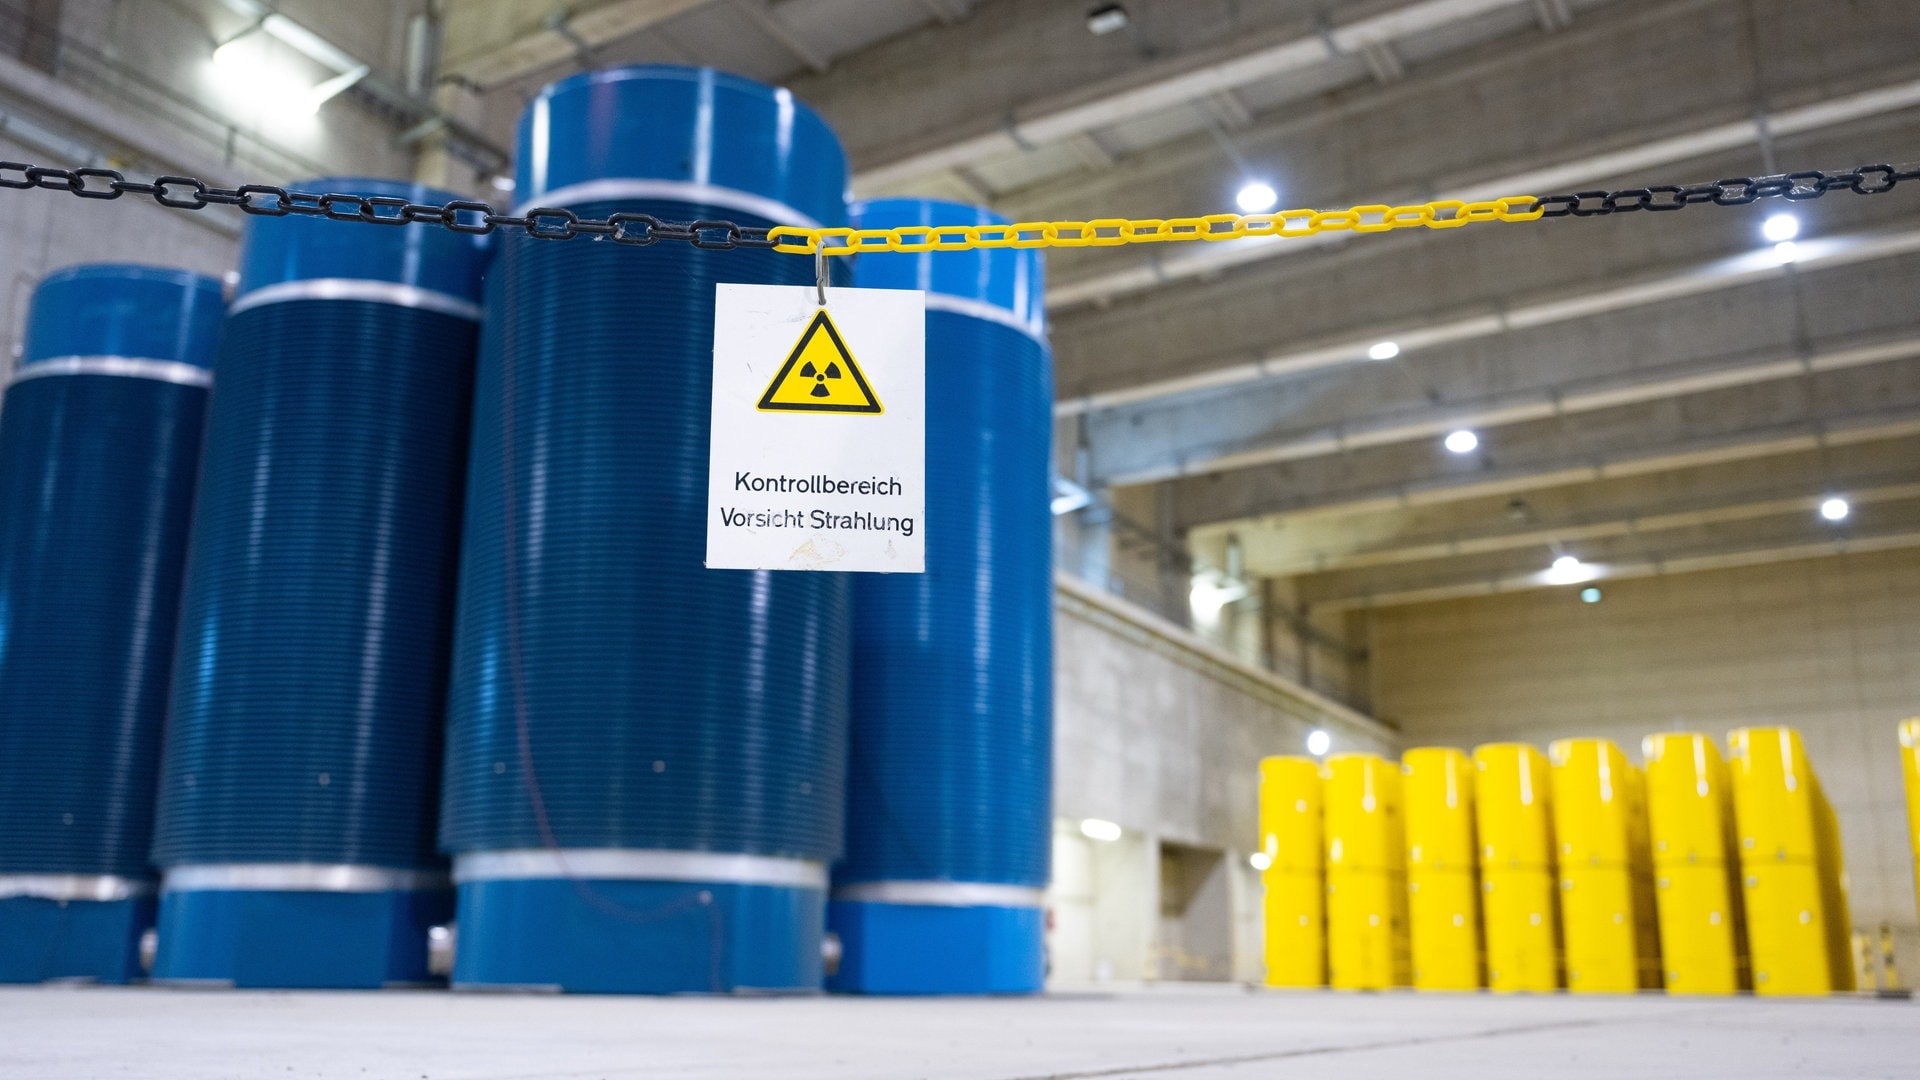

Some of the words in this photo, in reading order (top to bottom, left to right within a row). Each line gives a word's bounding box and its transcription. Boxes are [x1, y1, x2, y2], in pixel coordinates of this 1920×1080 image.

[735, 472, 902, 495] Kontrollbereich
[720, 507, 804, 529] Vorsicht
[810, 510, 914, 536] Strahlung
